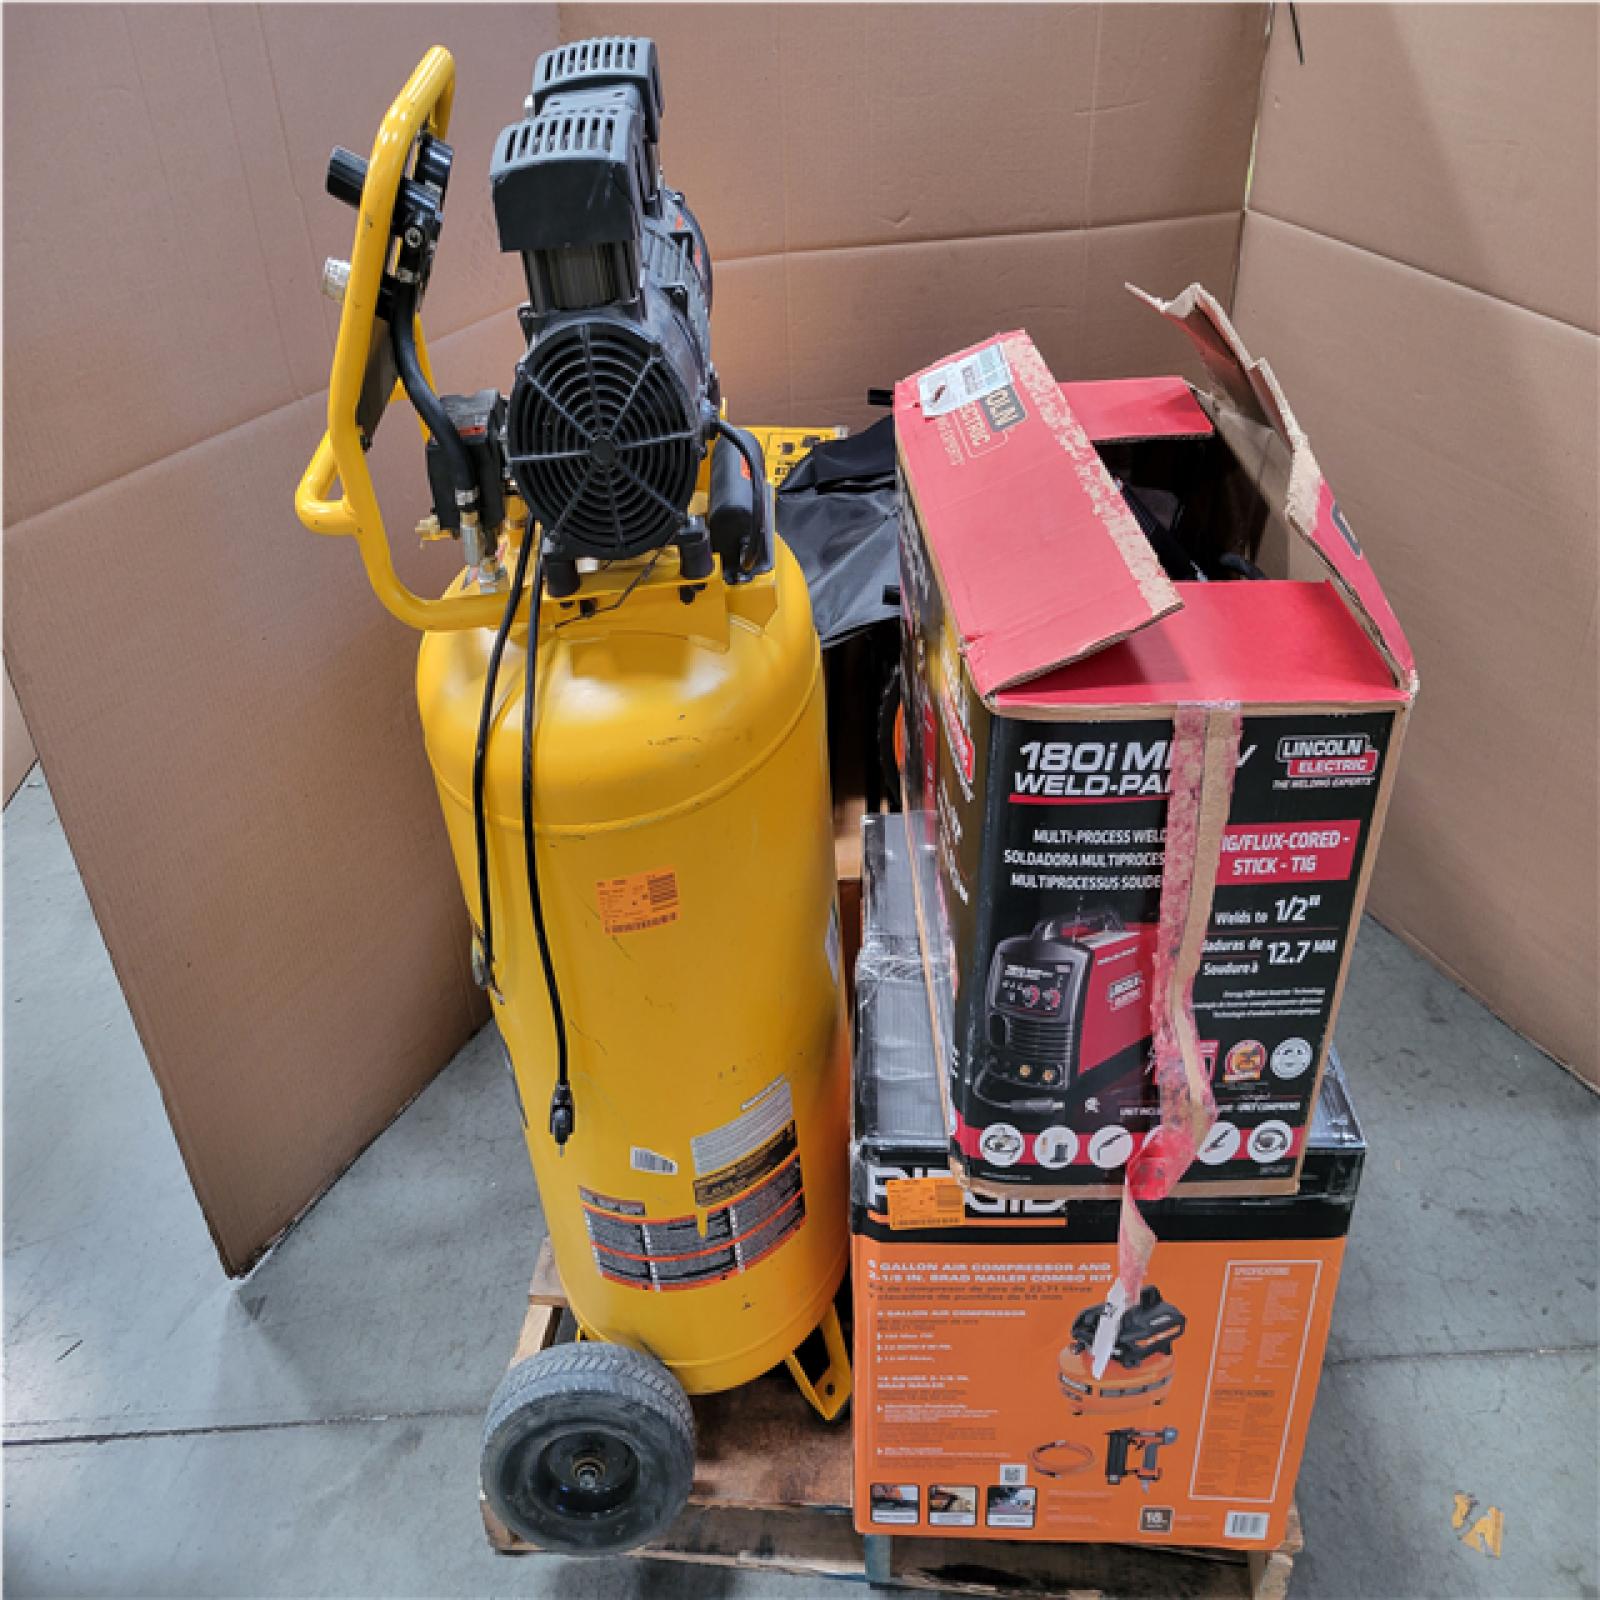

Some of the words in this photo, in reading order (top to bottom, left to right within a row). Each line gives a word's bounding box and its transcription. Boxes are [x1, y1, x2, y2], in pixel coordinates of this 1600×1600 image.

[1019, 740, 1119, 772] 180i
[1121, 740, 1173, 772] M
[1282, 739, 1363, 757] LINCOLN
[1297, 759, 1369, 774] ELECTRIC
[1013, 770, 1172, 797] WELD-PA
[1032, 829, 1131, 845] MULTI-PROCESS
[1221, 830, 1341, 853] IG/FLUX-CORED
[1004, 849, 1078, 867] SOLDADORA
[1232, 857, 1278, 876] STICK
[1290, 854, 1318, 873] TIG
[1214, 911, 1251, 926] Welds
[1254, 911, 1269, 924] to
[1247, 937, 1264, 951] de
[1267, 940, 1311, 965] 12.7
[1311, 939, 1338, 953] MM
[1202, 960, 1251, 976] Soudure
[879, 1262, 939, 1271] GALLON
[941, 1262, 969, 1271] AIR
[971, 1262, 1073, 1271] COMPRESSOR
[1077, 1262, 1112, 1271] AND
[974, 1273, 1026, 1282] NAILER
[1029, 1273, 1086, 1282] COMBO
